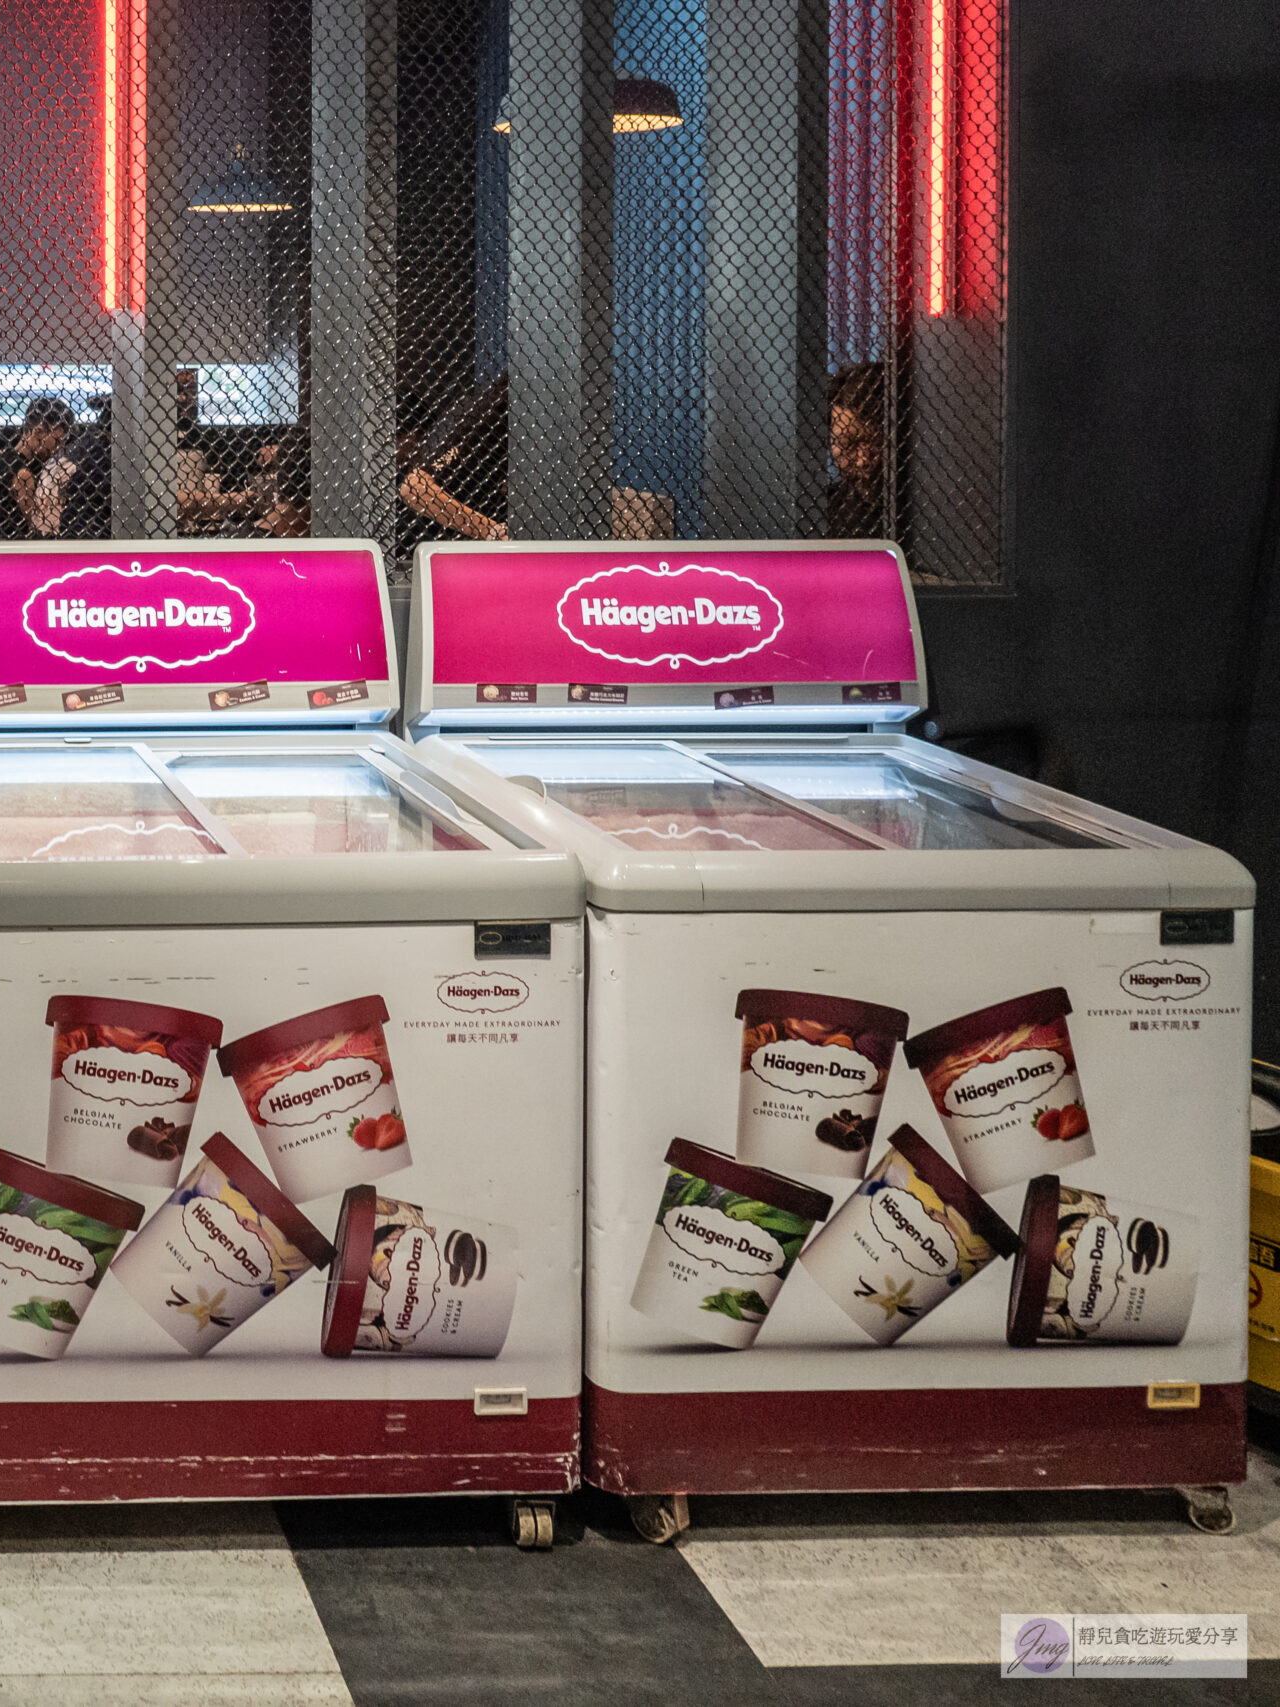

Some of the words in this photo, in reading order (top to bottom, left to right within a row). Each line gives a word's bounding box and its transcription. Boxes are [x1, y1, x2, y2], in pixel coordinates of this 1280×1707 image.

[47, 598, 232, 635] Häagen-Dazs
[580, 597, 761, 633] Häagen-Dazs
[447, 986, 520, 1000] Häagen-Dazs
[1130, 974, 1201, 988] Häagen-Dazs
[484, 1020, 561, 1028] EXTRAORDINARY
[74, 1059, 179, 1089] Häagen-Dazs
[762, 1052, 866, 1081] Häagen-Dazs
[268, 1070, 372, 1114] Häagen-Dazs
[953, 1061, 1055, 1105] Häagen-Dazs
[73, 1108, 115, 1120] BELGIAN
[752, 1108, 811, 1122] CHOCOLATE
[762, 1101, 803, 1112] BELGIAN
[63, 1115, 122, 1130] CHOCOLATE
[963, 1118, 1023, 1143] STRAWBERRY
[277, 1127, 338, 1153] STRAWBERRY
[191, 1203, 262, 1279] Häagen-Dazs
[675, 1213, 774, 1263] Häagen-Dazs
[879, 1194, 949, 1268] Häagen-Dazs
[165, 1240, 192, 1273] VANILLA
[853, 1231, 880, 1263] VANILLA
[668, 1260, 699, 1277] GREEN
[672, 1271, 688, 1283] TEA
[1080, 1225, 1106, 1319] Häagen-Dazs
[395, 1236, 423, 1331] Häagen-Dazs
[441, 1298, 454, 1334] COOKIES
[452, 1299, 463, 1327] CREAM
[1125, 1286, 1138, 1322] COOKIES
[1135, 1287, 1146, 1316] CREAM
